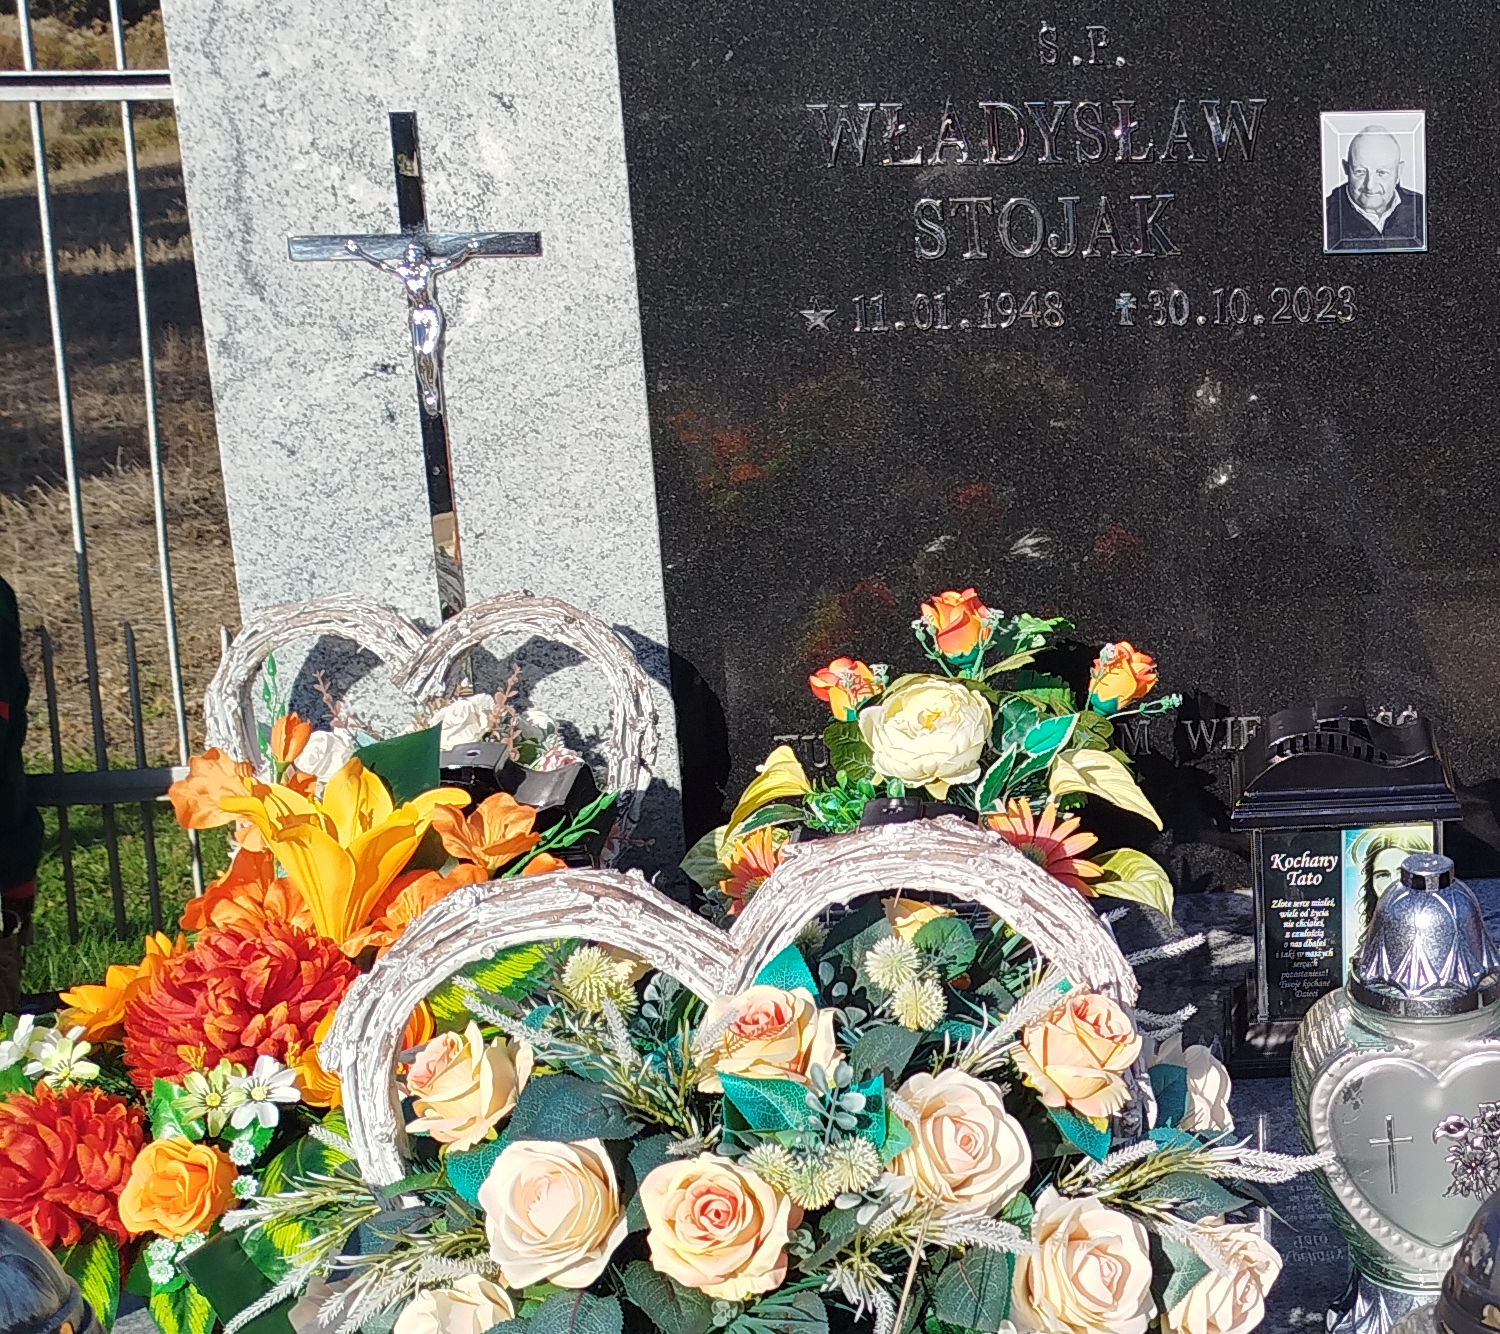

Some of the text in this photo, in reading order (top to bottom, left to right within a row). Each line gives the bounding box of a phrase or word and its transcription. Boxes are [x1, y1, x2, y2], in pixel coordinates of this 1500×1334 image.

[805, 98, 1268, 167] WŁADYSŁAW
[914, 194, 1182, 261] STOJAK
[852, 285, 1359, 333] 11.01.1948 30.10.2023
[1271, 851, 1338, 872] Kochany
[1287, 870, 1322, 886] Tato
[1279, 908, 1298, 918] wiele
[1299, 908, 1310, 917] od
[1283, 919, 1294, 928] nie
